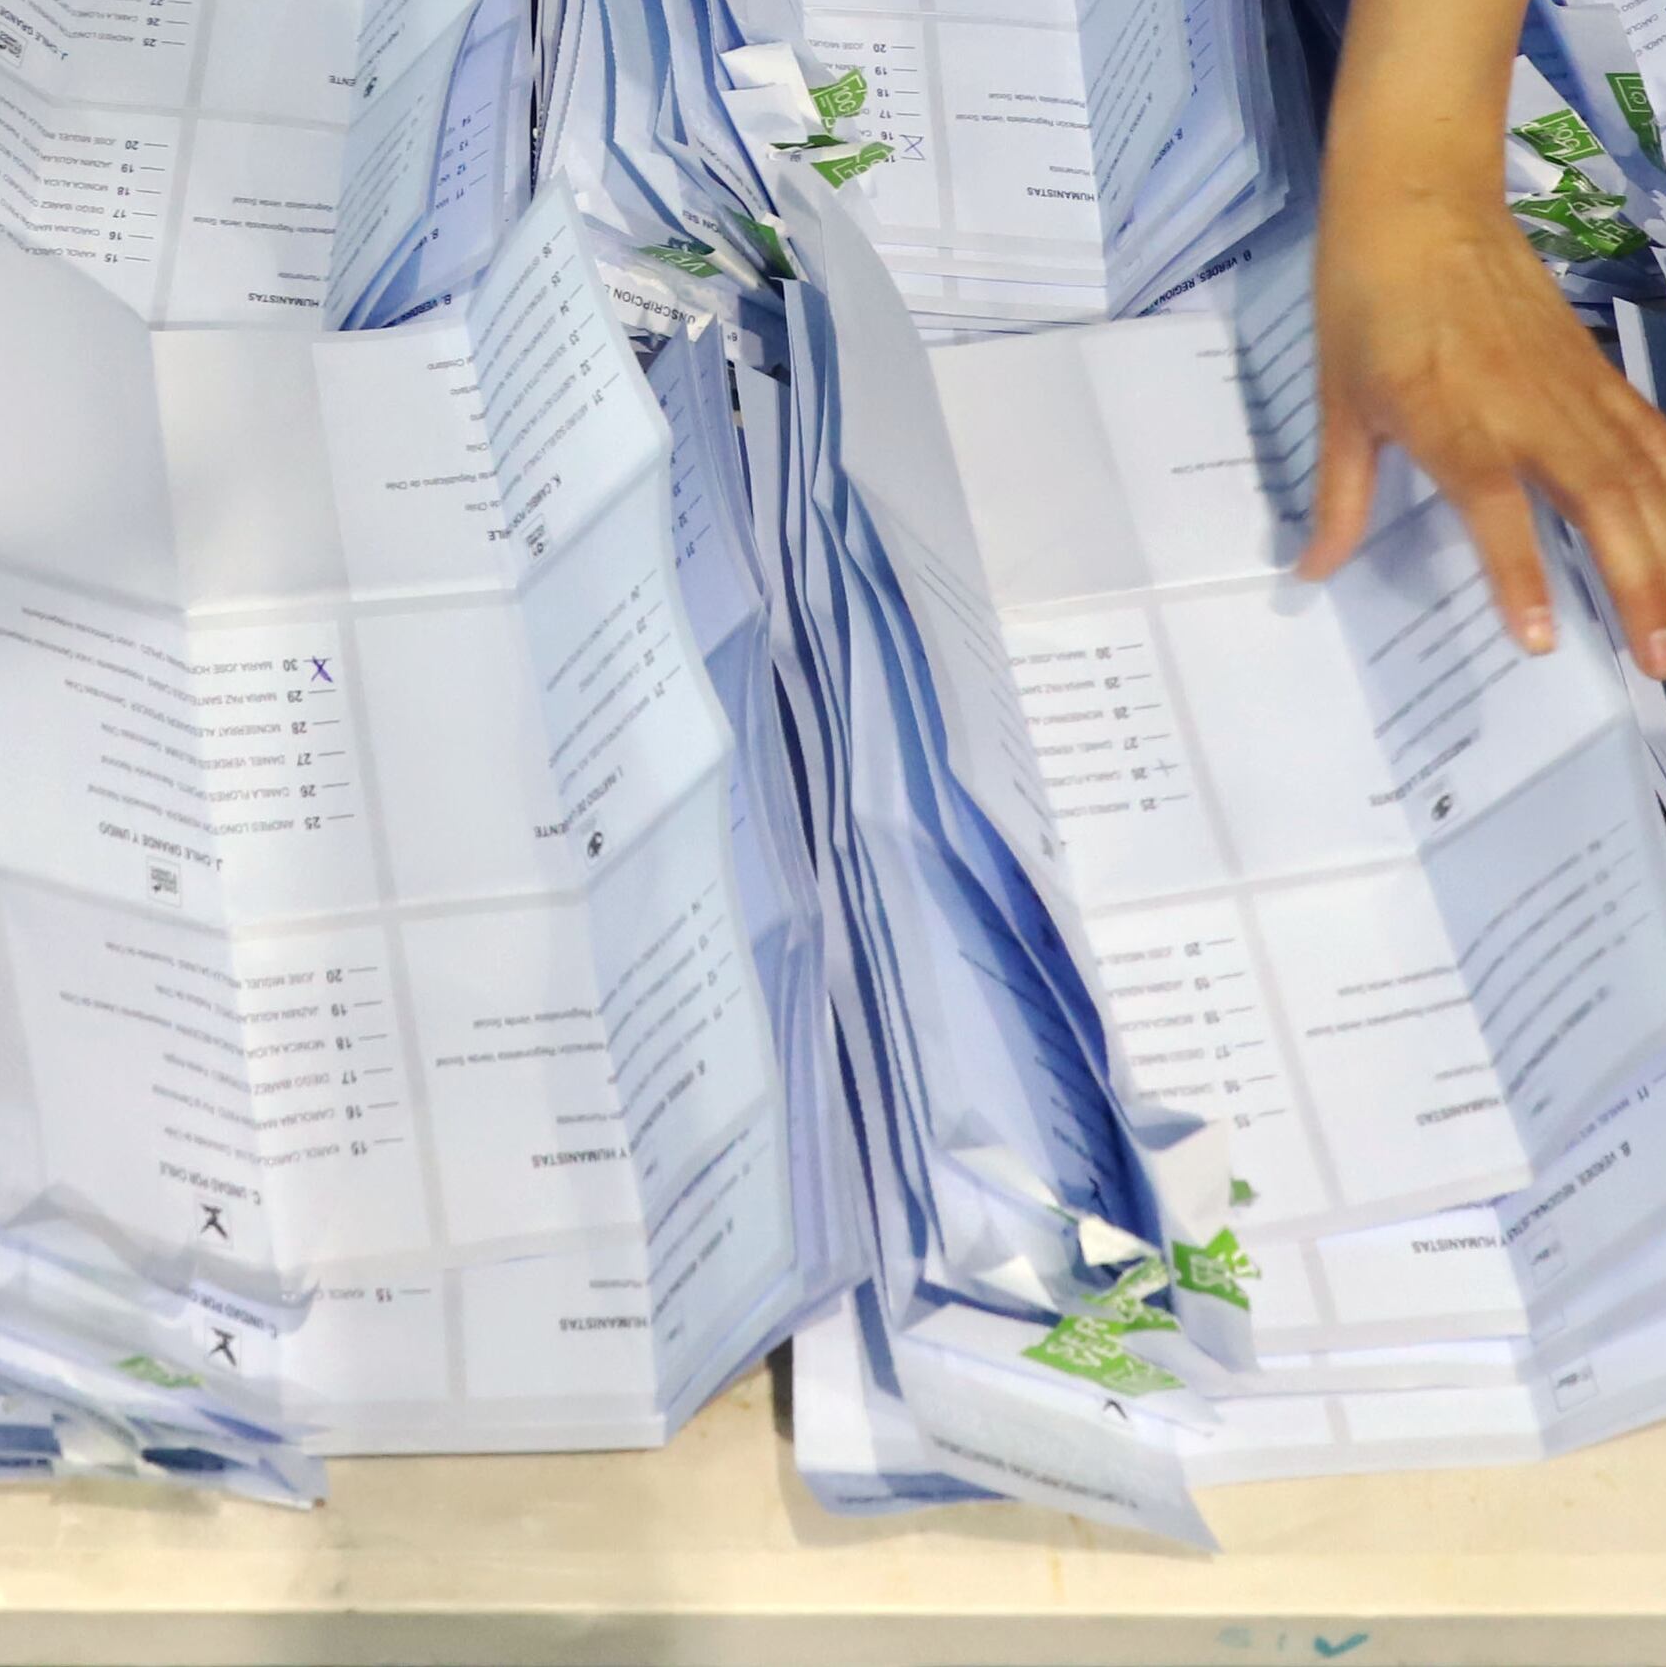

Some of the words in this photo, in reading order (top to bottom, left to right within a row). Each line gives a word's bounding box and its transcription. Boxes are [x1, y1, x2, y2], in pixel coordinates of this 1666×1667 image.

[1027, 187, 1095, 202] HUMANISTAS
[248, 293, 320, 308] HUMANISTAS
[283, 659, 298, 671] 30
[287, 691, 303, 703] 29
[292, 722, 307, 734] 28
[297, 753, 311, 766] 27
[300, 785, 316, 797] 26
[305, 817, 321, 829] 25
[325, 969, 343, 983] 20
[331, 1003, 347, 1016] 19
[335, 1036, 352, 1049] 18
[532, 1148, 616, 1167] HUMANISTAS
[1411, 1235, 1497, 1254] HUMANISTAS
[559, 1317, 647, 1331] HUMANISTAS
